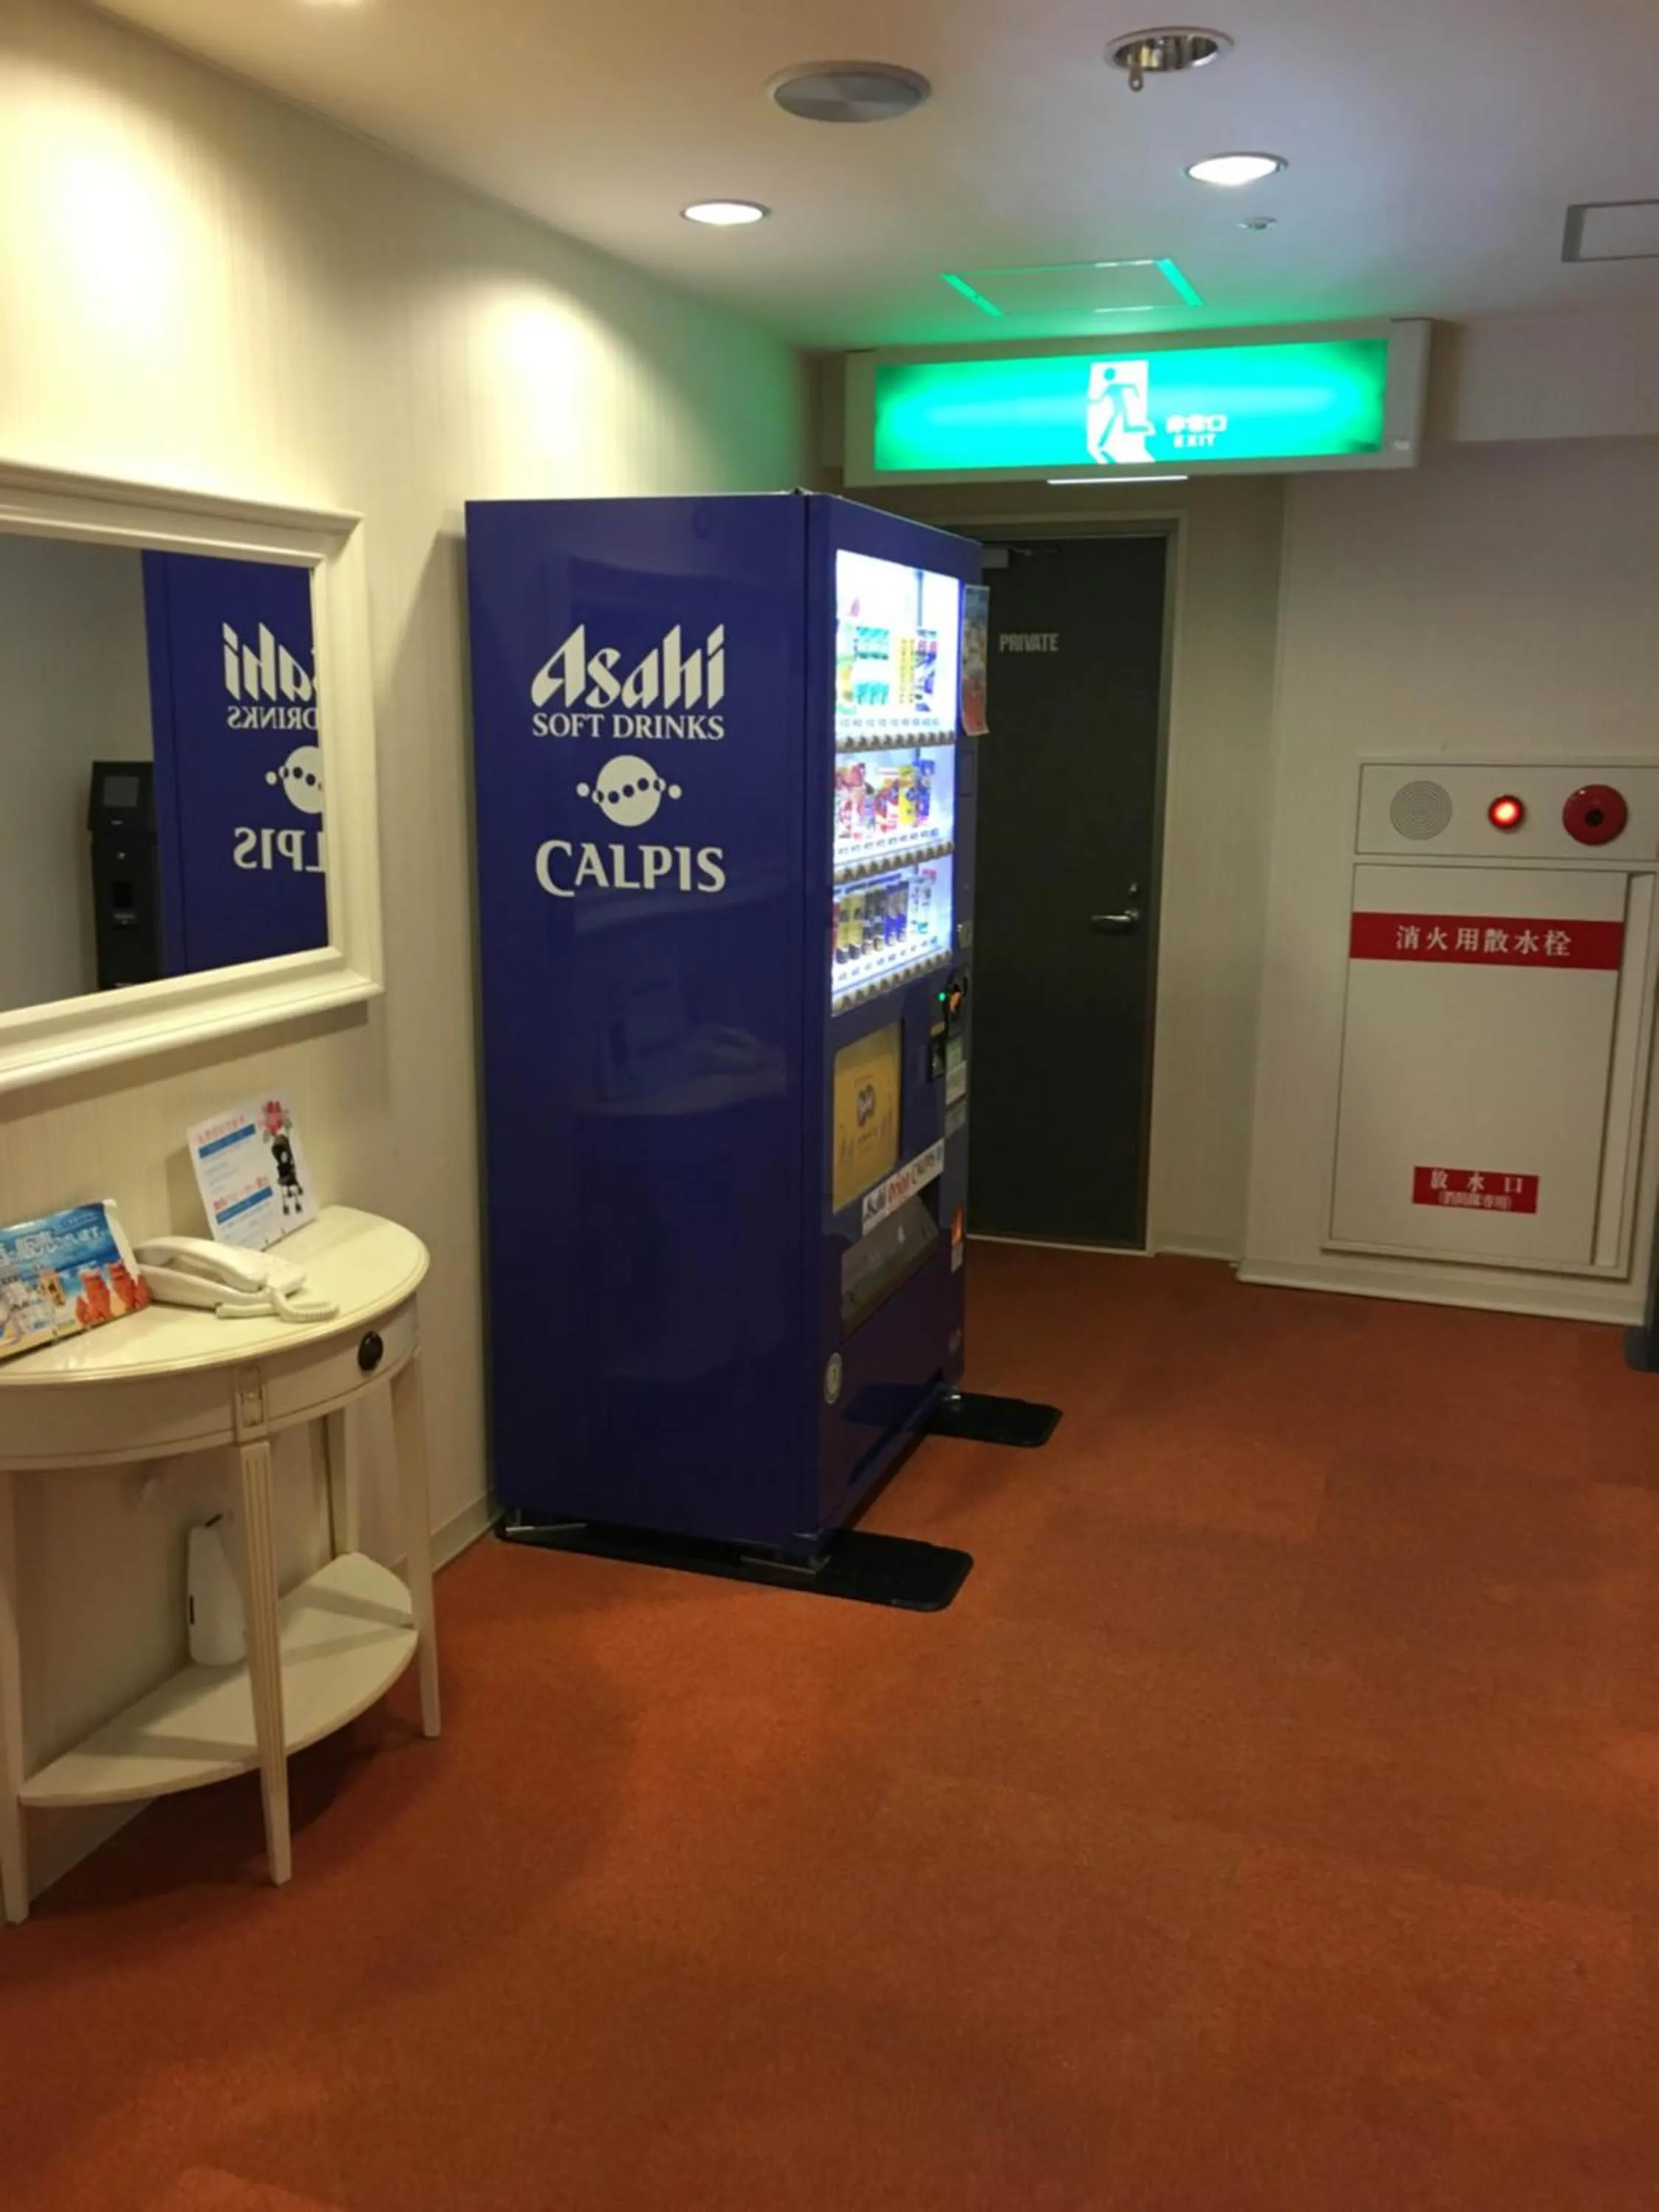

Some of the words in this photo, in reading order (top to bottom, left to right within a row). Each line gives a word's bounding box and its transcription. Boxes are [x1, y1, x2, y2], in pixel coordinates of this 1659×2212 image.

[999, 633, 1060, 653] PRIVATE
[531, 623, 725, 709] Asahi
[532, 712, 605, 737] SOFT
[613, 714, 725, 740] DRINKS
[535, 839, 726, 897] CALPIS
[1396, 924, 1573, 957] 消火用散水栓
